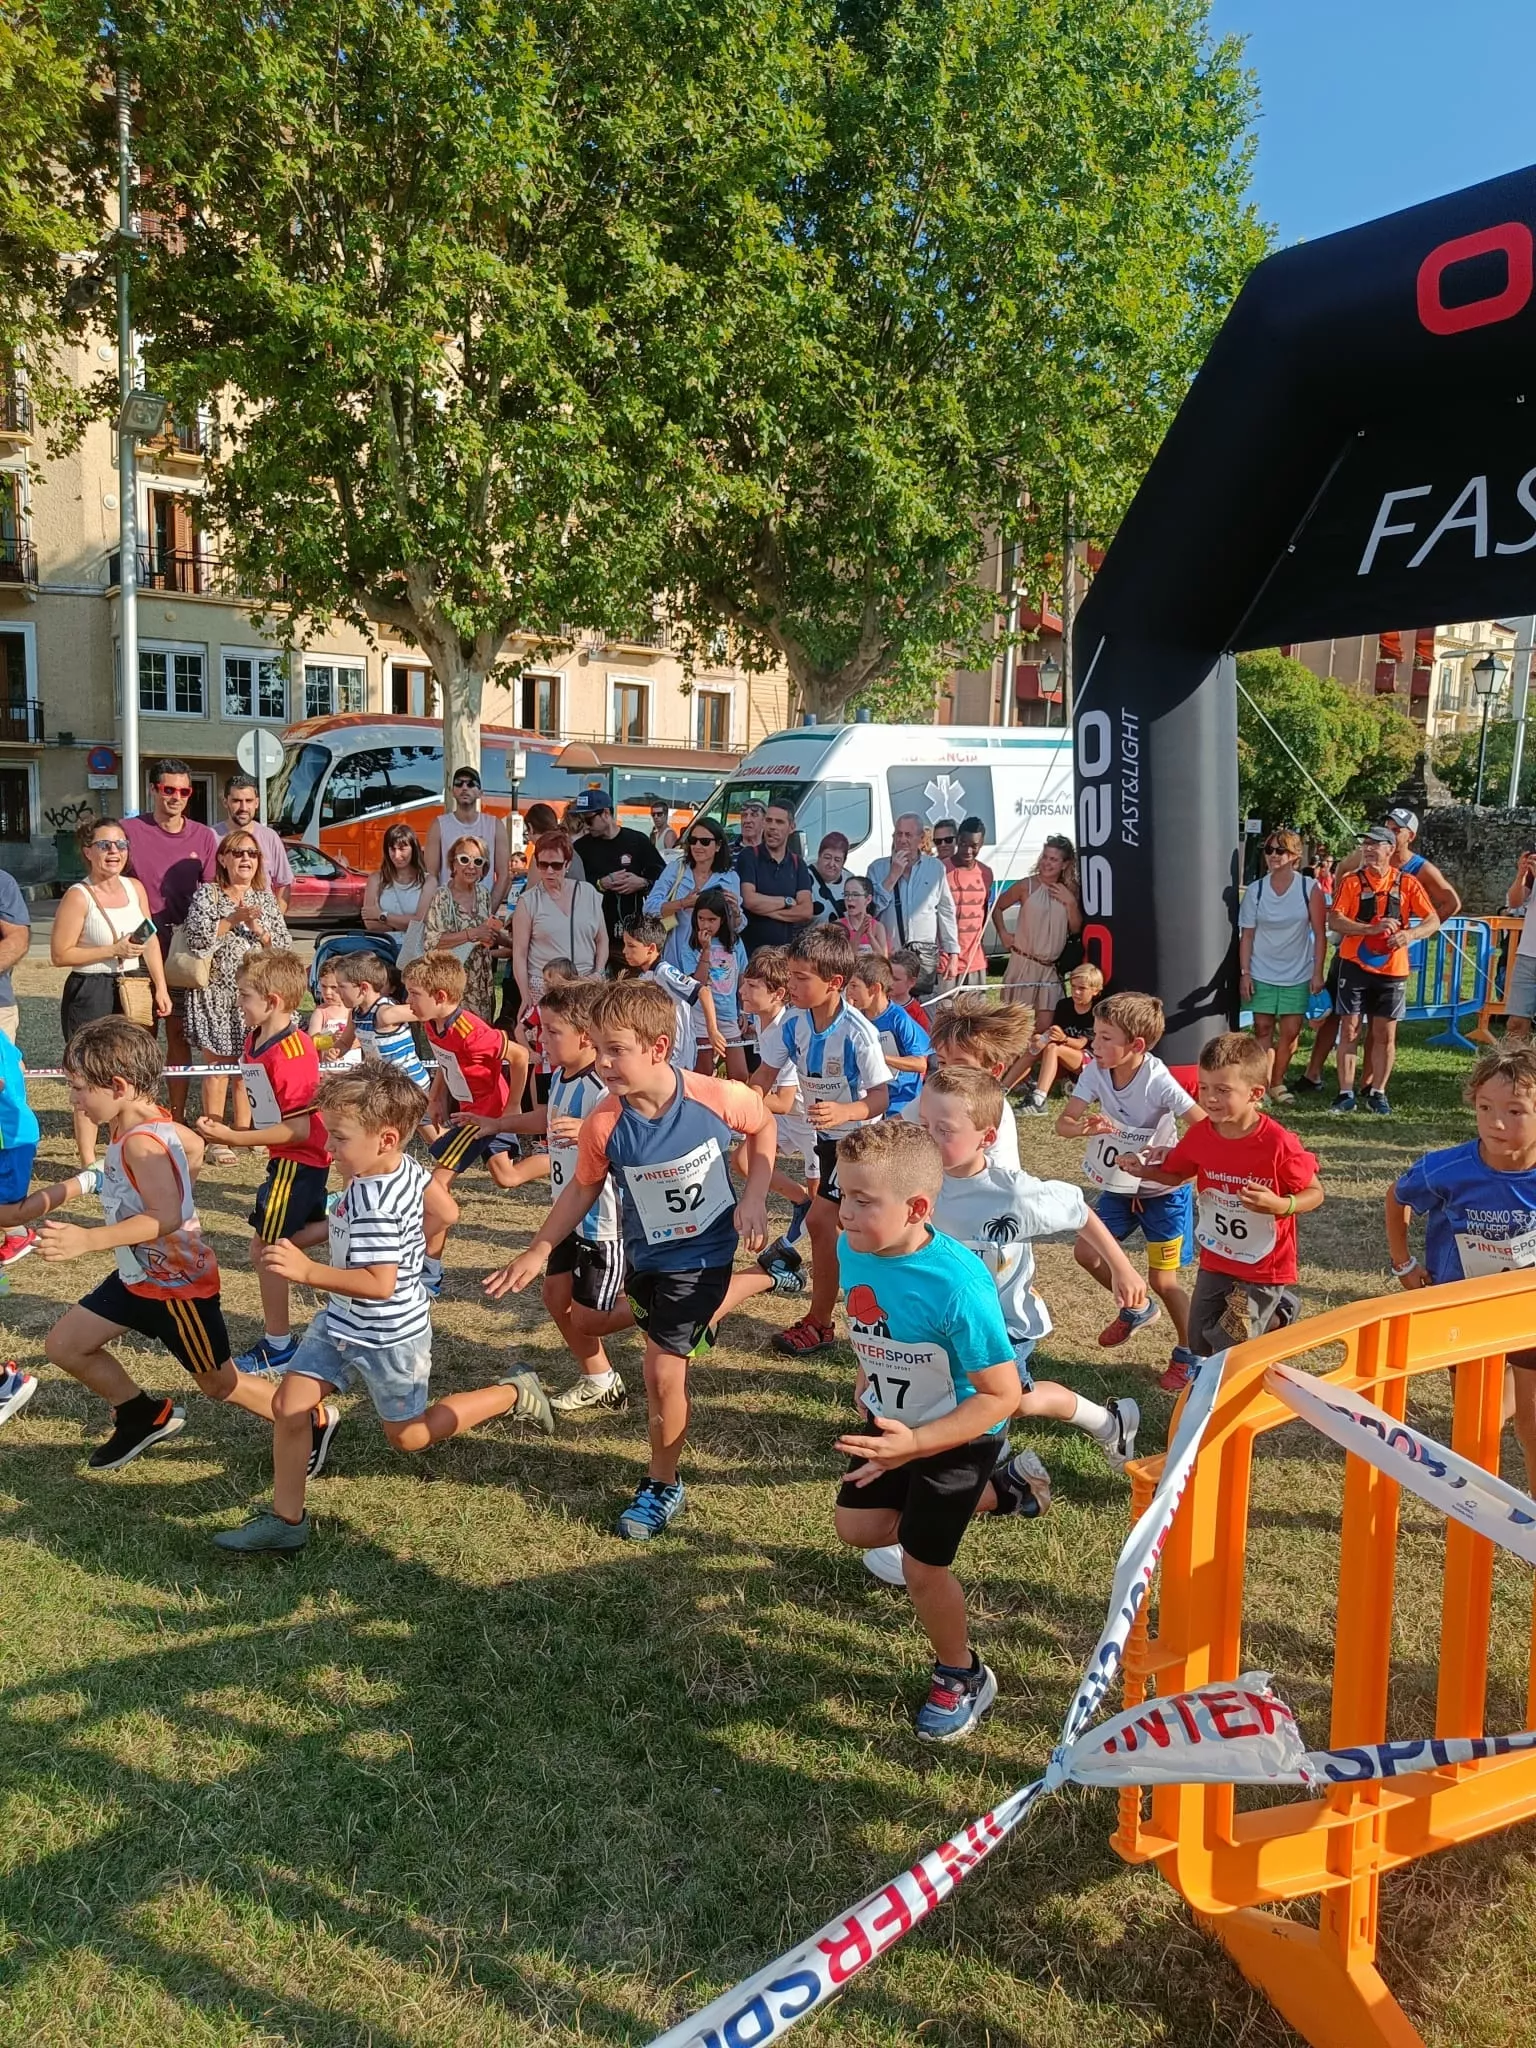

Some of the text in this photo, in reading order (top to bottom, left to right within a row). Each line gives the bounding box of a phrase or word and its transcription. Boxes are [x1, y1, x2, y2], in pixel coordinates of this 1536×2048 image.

[1121, 707, 1140, 847] FAST&LIGHT
[552, 1161, 564, 1186] 8
[643, 1151, 712, 1181] INTERSPORT
[665, 1183, 706, 1213] 52
[1214, 1212, 1248, 1240] 56
[1465, 1209, 1511, 1224] TOLOSAKO
[868, 1373, 911, 1409] 17
